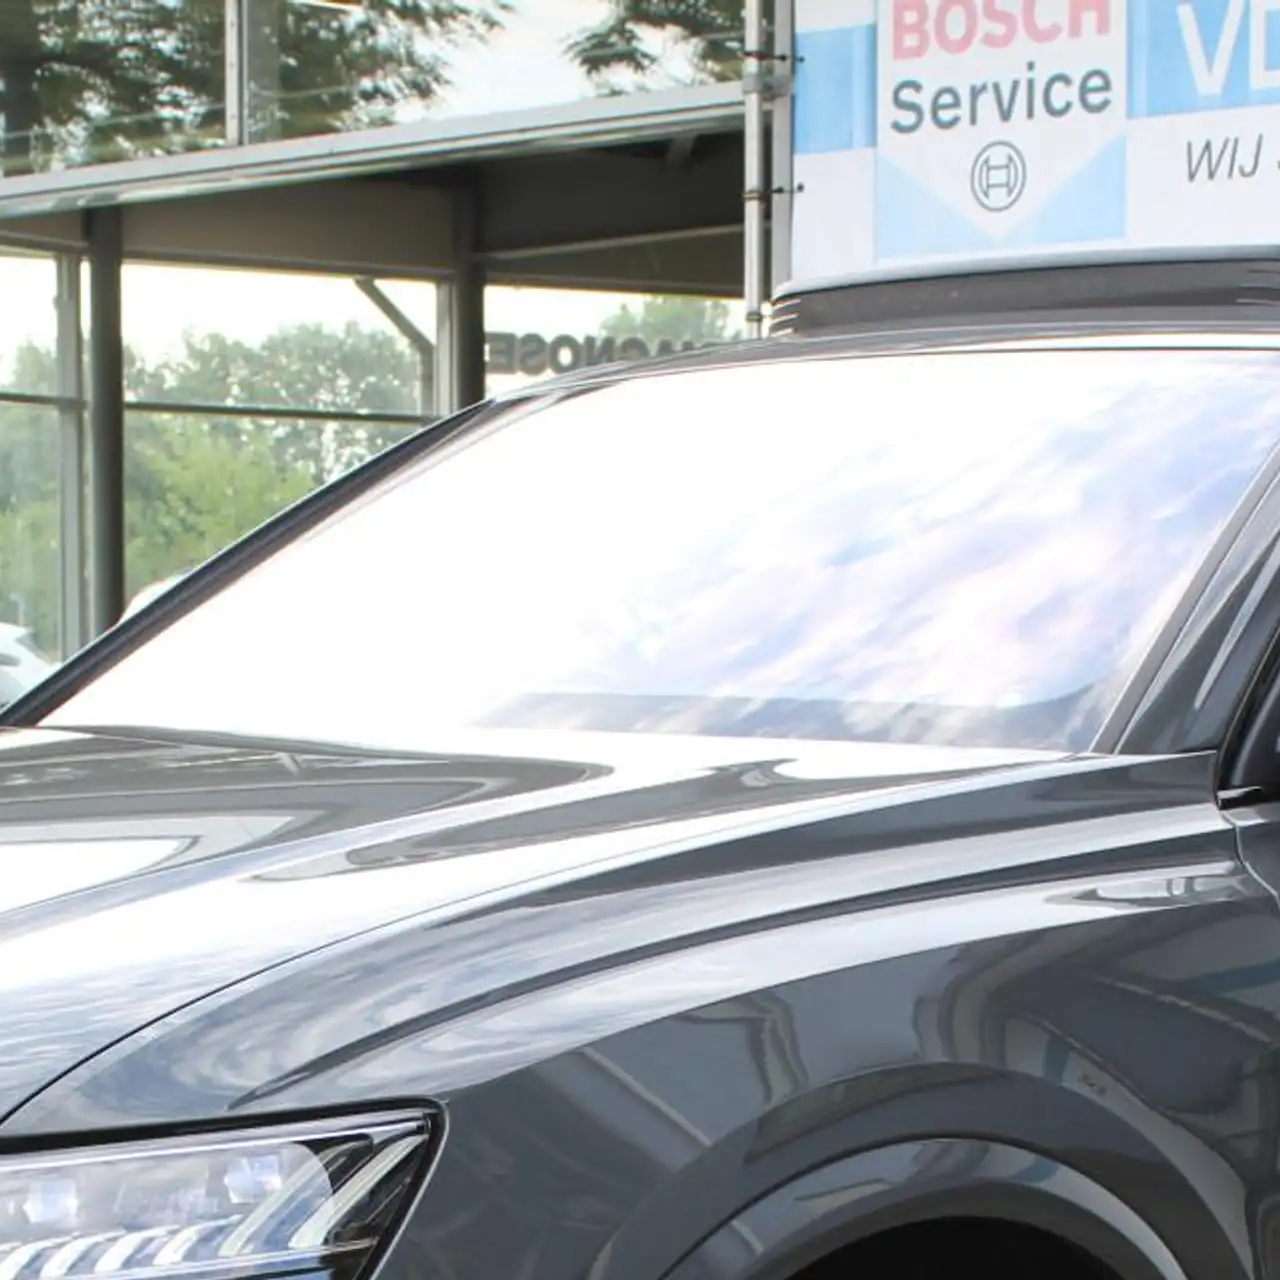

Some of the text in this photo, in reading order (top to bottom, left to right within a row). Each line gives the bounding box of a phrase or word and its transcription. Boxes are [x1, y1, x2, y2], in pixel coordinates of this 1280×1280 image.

[892, 0, 1111, 61] BOSCH
[890, 60, 1113, 134] Service
[1184, 132, 1264, 184] WIJ
